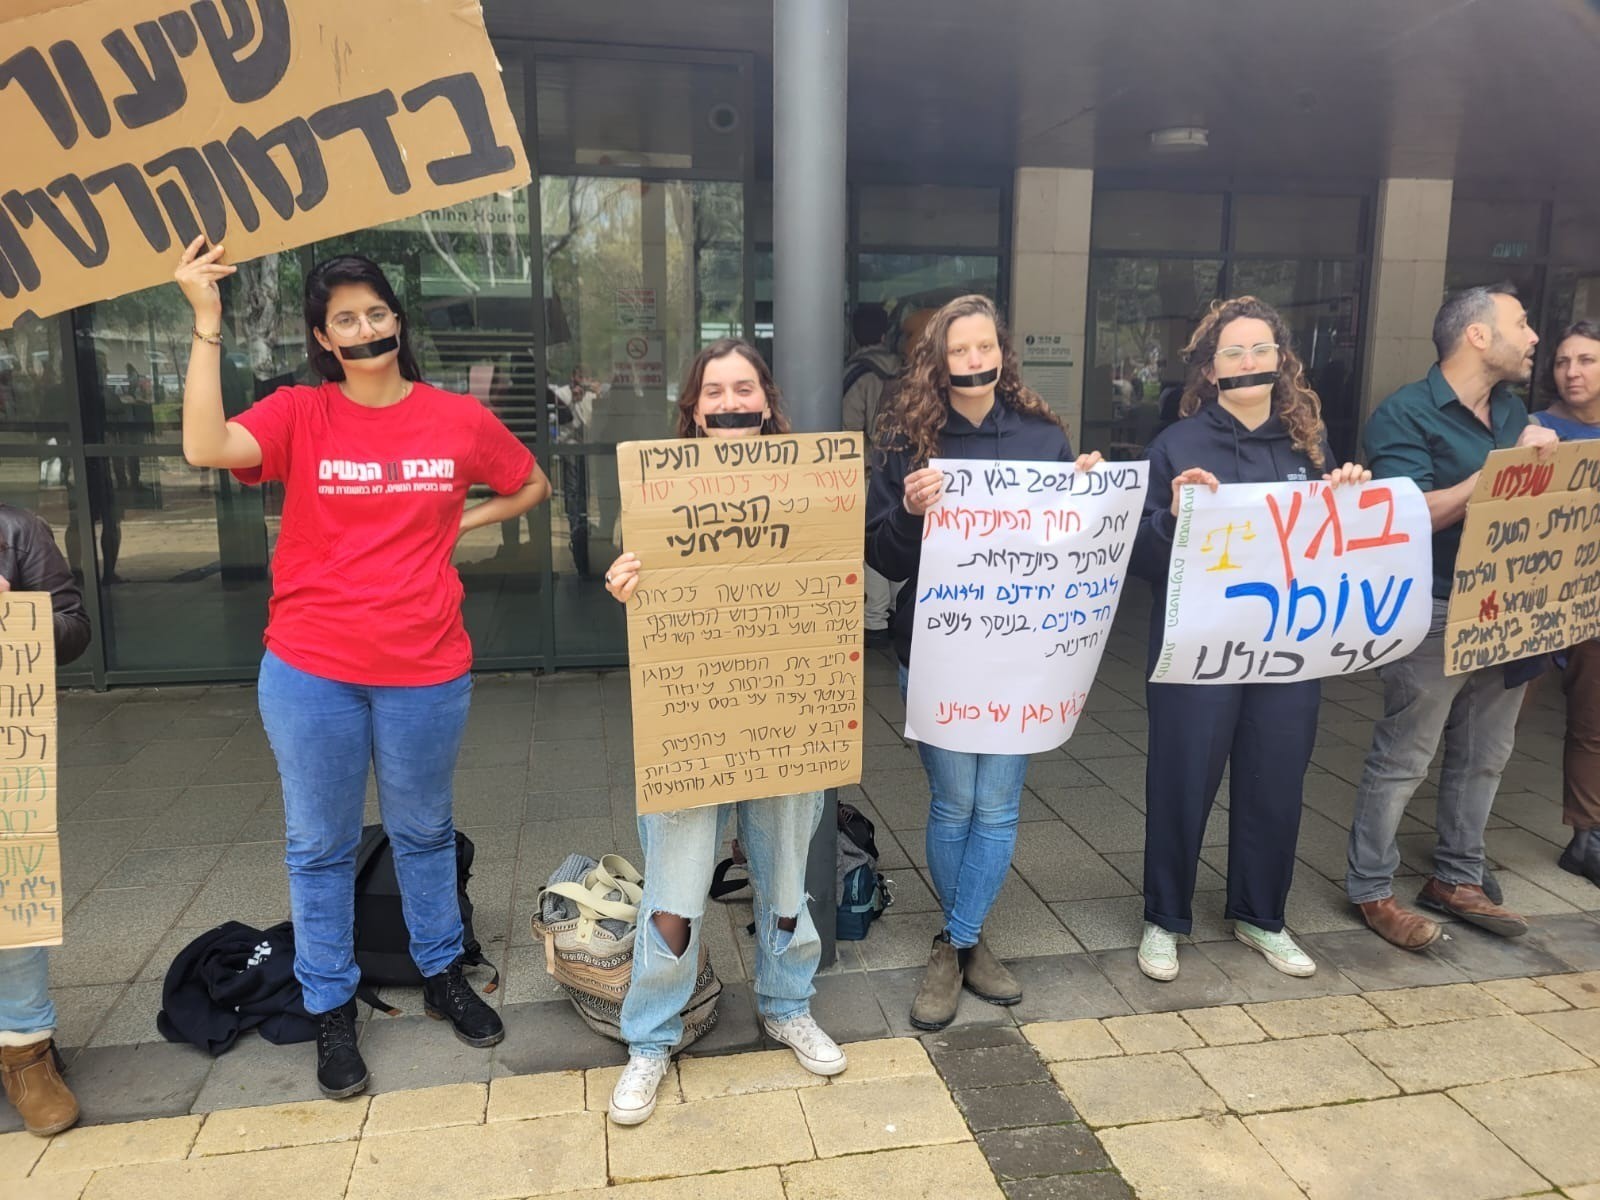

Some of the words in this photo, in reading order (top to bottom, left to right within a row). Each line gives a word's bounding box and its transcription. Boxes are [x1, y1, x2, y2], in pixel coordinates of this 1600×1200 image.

[0, 0, 291, 150] שיעור
[714, 440, 799, 467] המשפט
[813, 437, 861, 464] בית
[319, 459, 382, 481] הנשים
[402, 458, 455, 480] מאבק
[639, 443, 699, 484] העליון
[762, 472, 789, 492] על
[804, 468, 857, 489] שומר
[984, 462, 1020, 496] בג"ץ
[1026, 468, 1075, 493] 2021
[1070, 469, 1141, 496] בשנת
[632, 480, 674, 504] יסוד
[825, 494, 856, 512] של
[672, 495, 770, 529] הציבור
[779, 497, 810, 513] כל
[923, 506, 1031, 541] הפונדקאות
[1042, 509, 1081, 541] חוק
[1093, 510, 1129, 539] את
[666, 524, 790, 557] הישראלי
[1266, 482, 1410, 591] בג"ץ
[957, 549, 1059, 577] פונדקאות
[1068, 543, 1125, 575] שהתיר
[715, 581, 780, 603] שאישה
[795, 575, 842, 599] קבע
[919, 583, 984, 604] ולזוגות
[1065, 574, 1119, 599] לגברים
[634, 585, 699, 611] זכאית
[811, 600, 857, 616] לחצי
[647, 608, 719, 634] המשותף
[729, 604, 799, 622] מהרכוש
[928, 612, 972, 635] לנשים
[1092, 605, 1111, 622] חד
[789, 620, 816, 635] ושל
[826, 618, 859, 633] שלה
[980, 614, 1031, 639] בנוסף
[643, 631, 667, 650] לדין
[672, 631, 695, 645] קשר
[837, 633, 859, 644] דתי
[784, 656, 810, 671] את
[817, 652, 846, 669] חייב
[1192, 640, 1305, 681] כולנו
[1330, 638, 1404, 672] על
[642, 666, 684, 688] למגן
[697, 657, 769, 679] הממשלה
[828, 671, 857, 686] את
[660, 682, 715, 697] לימוד
[728, 675, 784, 693] הכיתות
[794, 673, 816, 687] כל
[660, 700, 699, 717] עילת
[747, 693, 767, 705] על
[776, 692, 807, 704] עזה
[798, 703, 856, 716] הסבירות
[988, 701, 1010, 723] על
[1021, 704, 1053, 734] מגן
[740, 725, 797, 742] שאסור
[808, 720, 844, 736] קבע
[662, 732, 726, 757] להפלות
[766, 745, 790, 758] חד
[800, 739, 853, 756] זוגות
[709, 771, 737, 788] זוג
[744, 767, 769, 783] בני
[778, 760, 851, 778] שמקבלים
[642, 777, 705, 802] מהמעסיק
